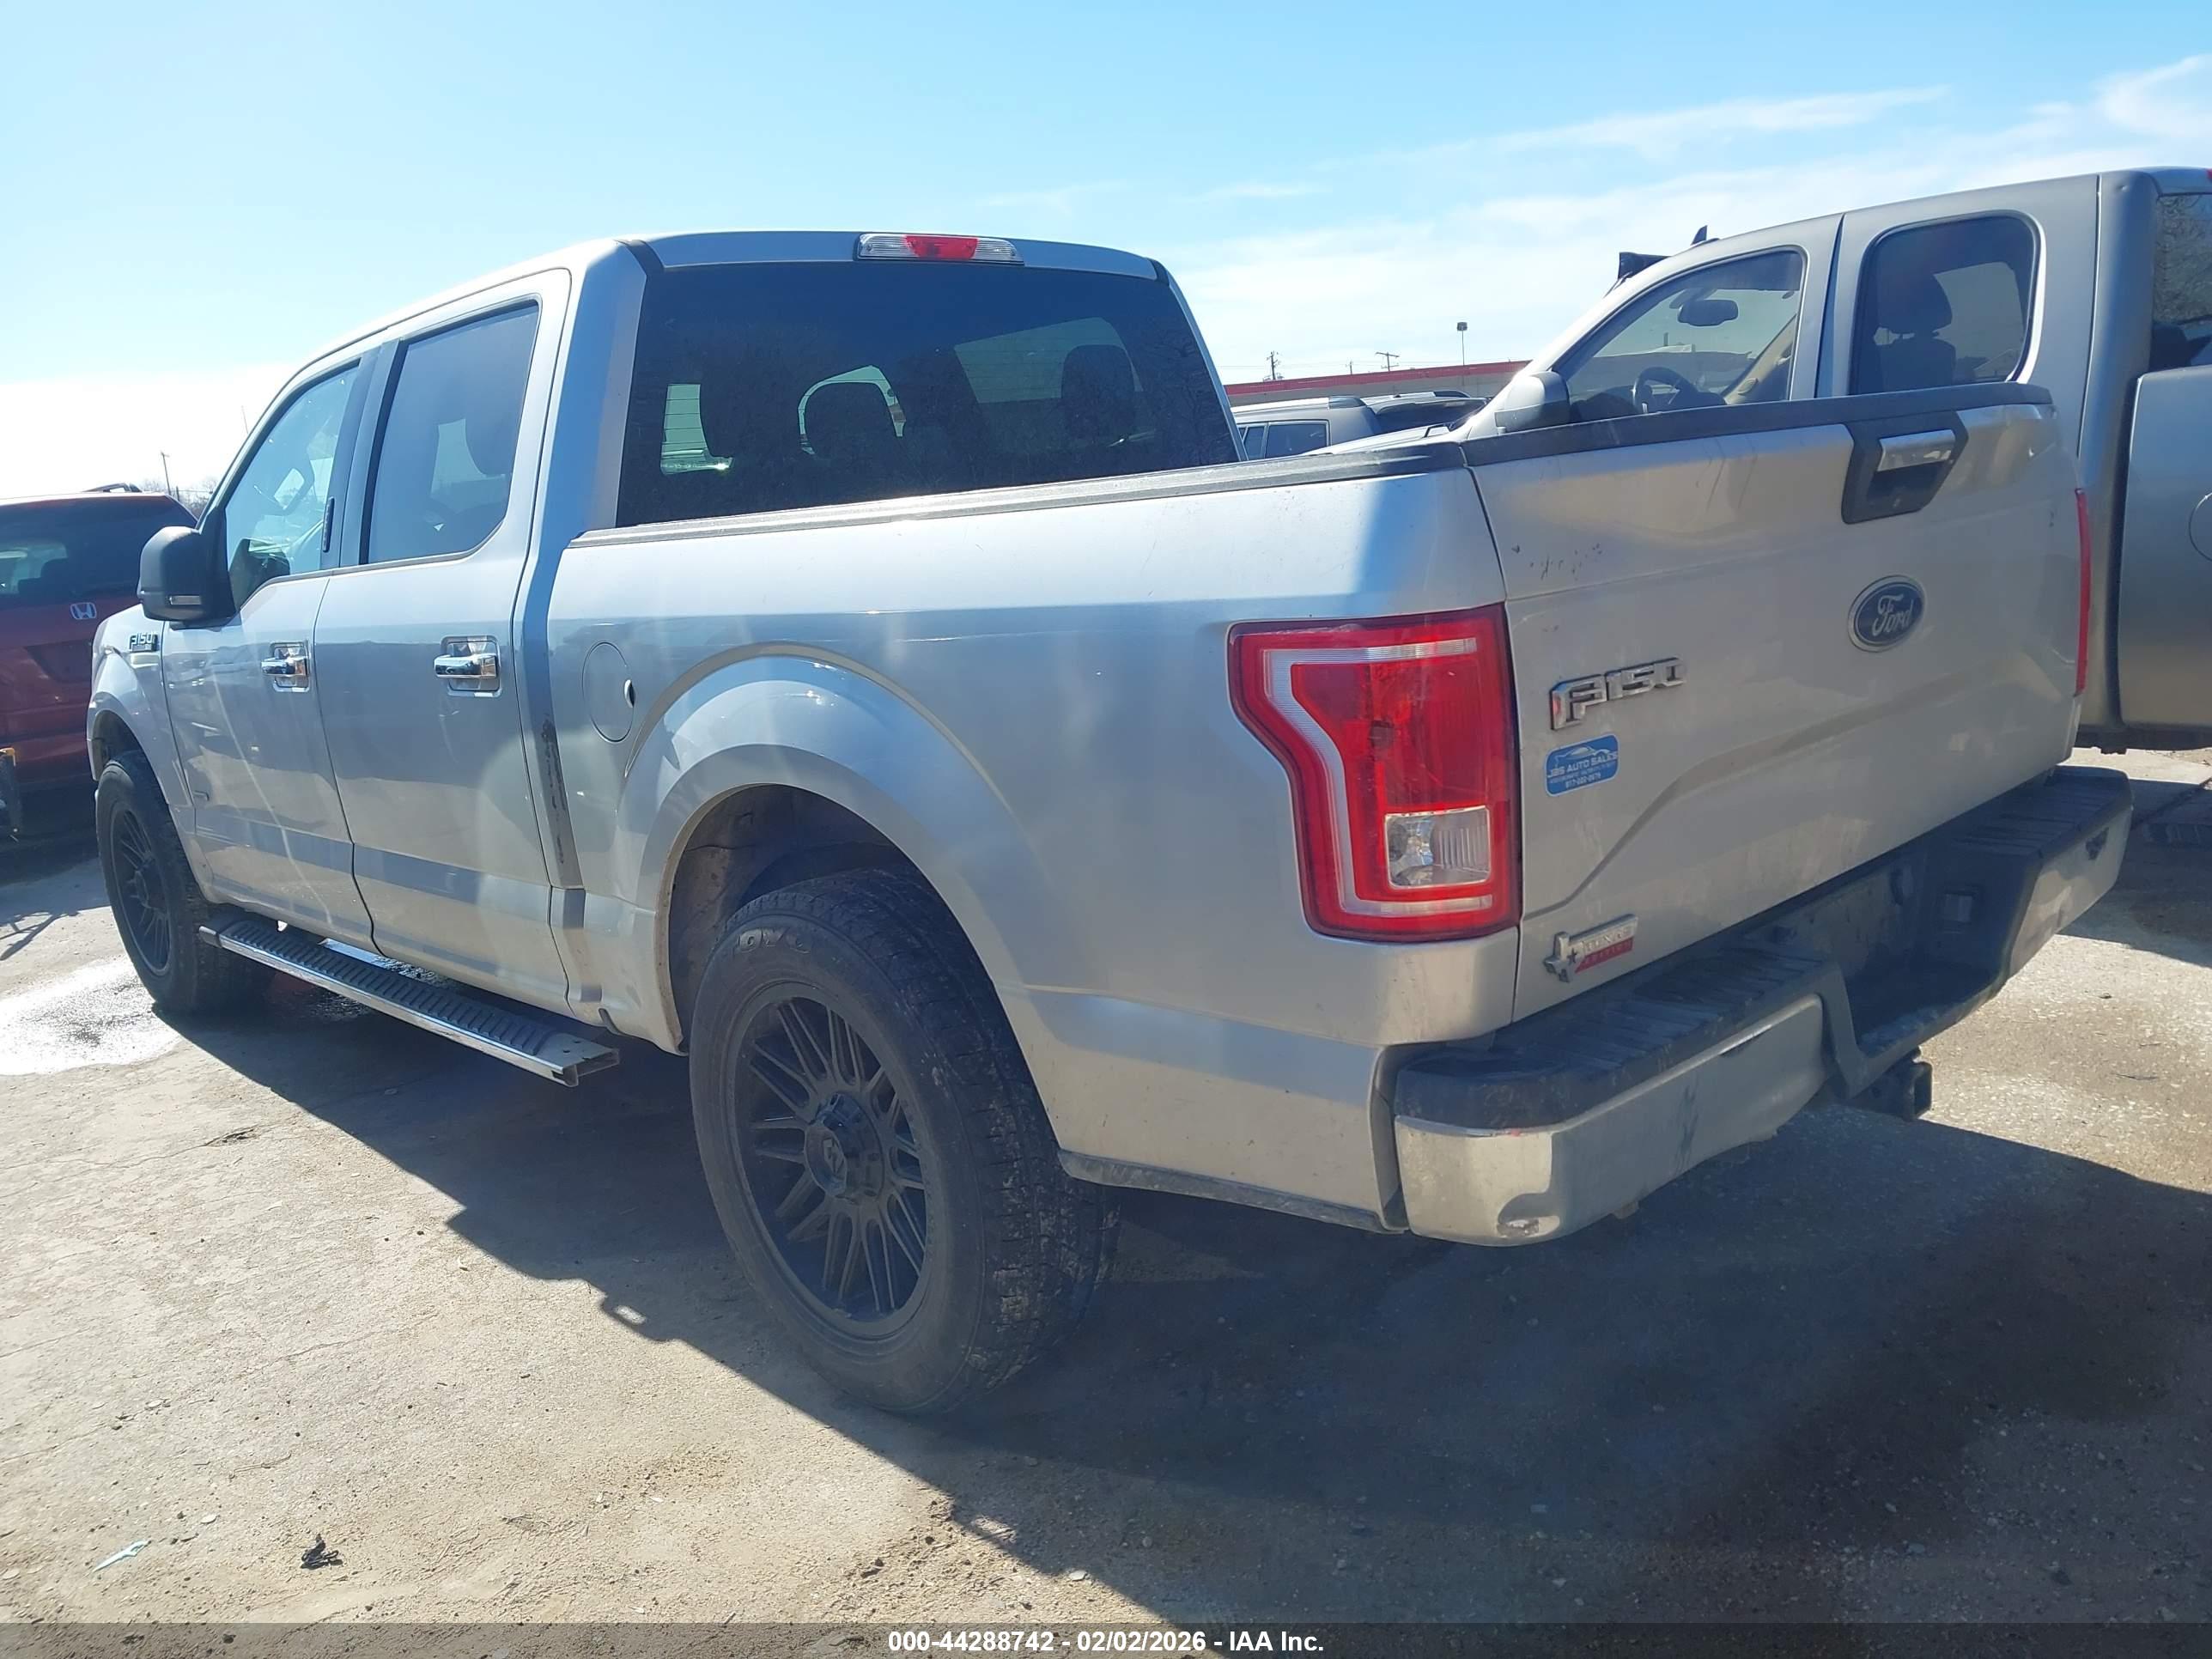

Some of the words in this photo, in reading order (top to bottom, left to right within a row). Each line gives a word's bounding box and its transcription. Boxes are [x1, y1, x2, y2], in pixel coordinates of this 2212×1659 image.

[1872, 593, 1914, 636] Ford
[1566, 759, 1590, 772] AUTO
[1591, 752, 1618, 766] SALES
